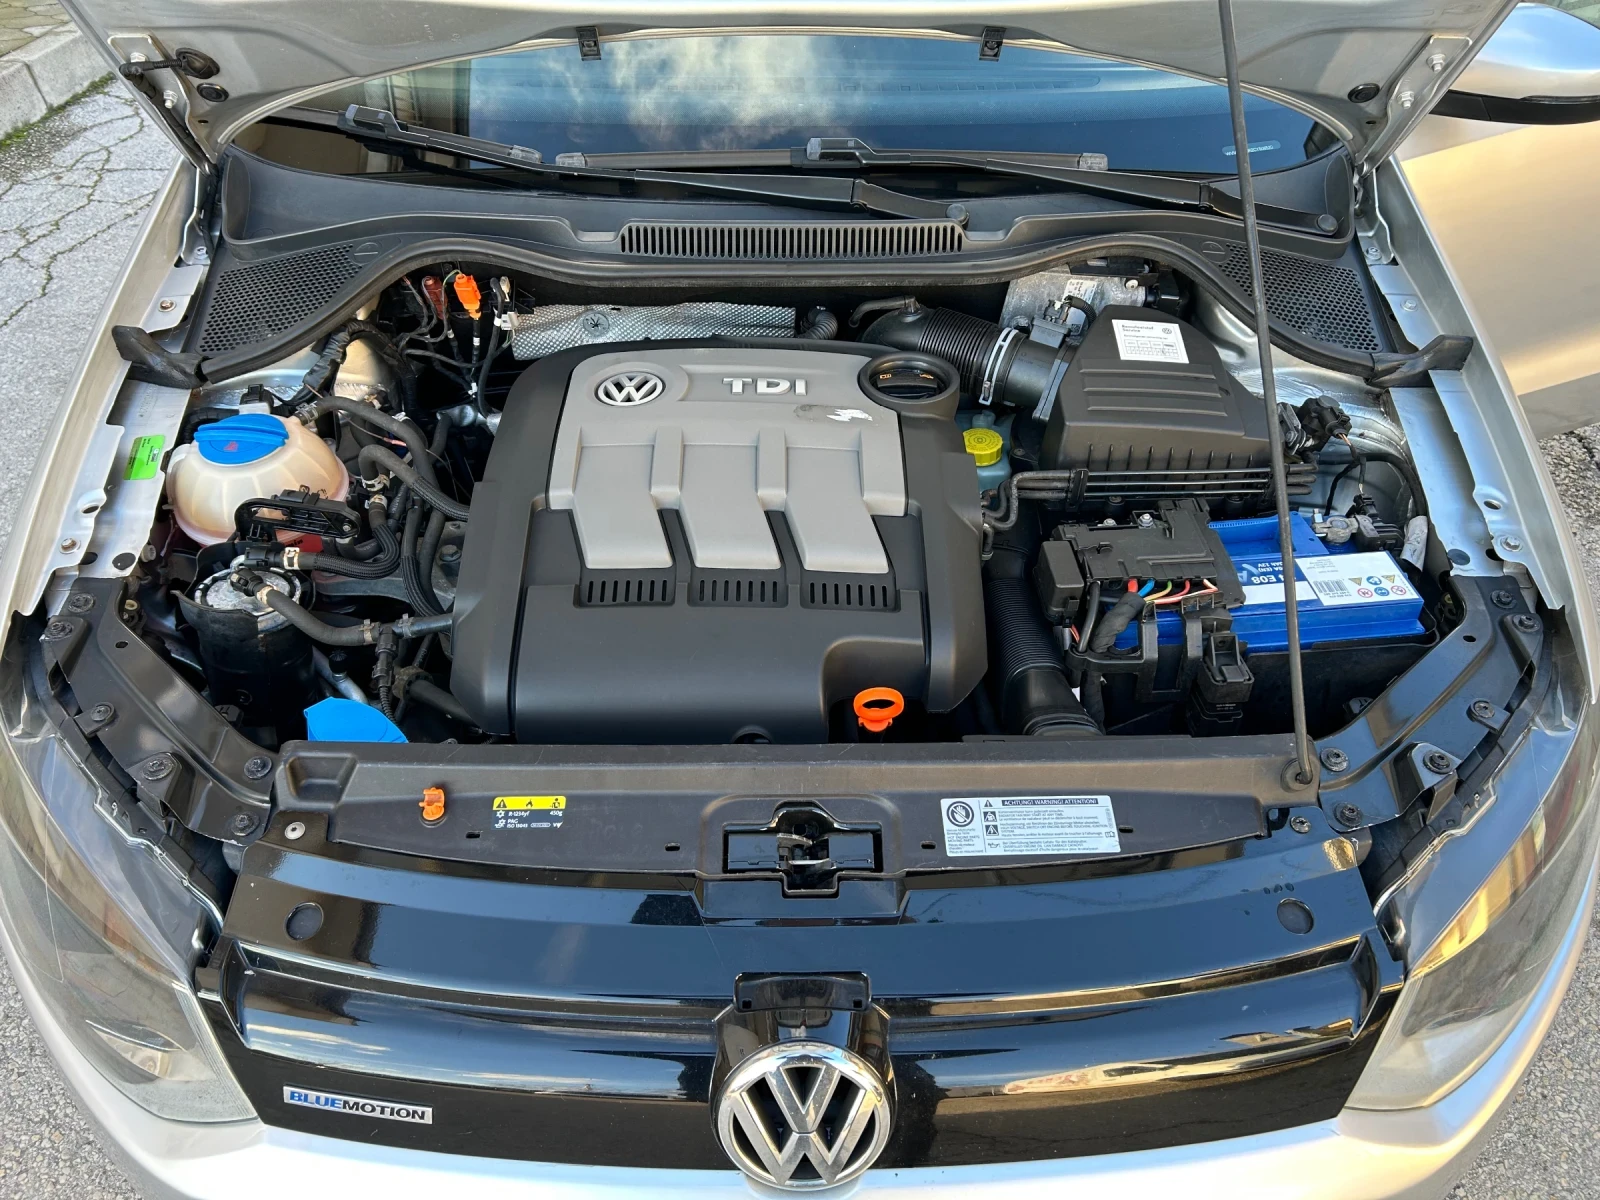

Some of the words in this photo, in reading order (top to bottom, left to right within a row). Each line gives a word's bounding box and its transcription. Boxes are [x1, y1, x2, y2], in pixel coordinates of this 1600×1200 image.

[722, 377, 807, 396] TDI
[1251, 575, 1277, 585] E08
[289, 1090, 426, 1121] BLUEMOTION
